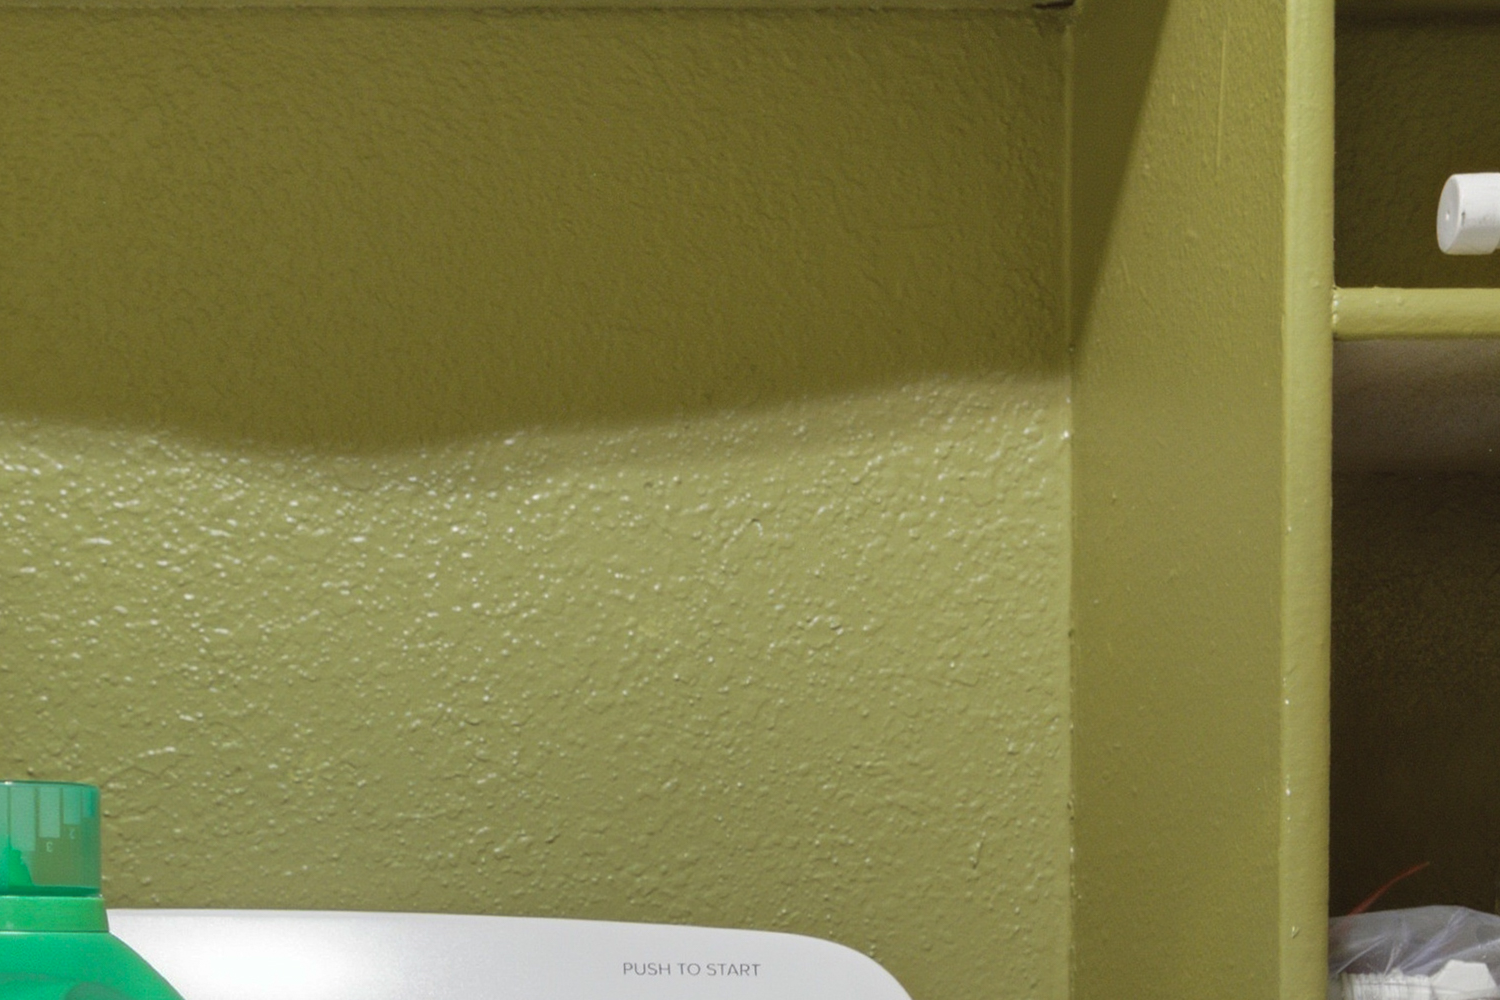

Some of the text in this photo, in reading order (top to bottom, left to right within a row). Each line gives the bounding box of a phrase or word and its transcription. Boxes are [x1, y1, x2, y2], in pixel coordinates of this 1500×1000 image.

[622, 961, 761, 977] PUSH TO START
